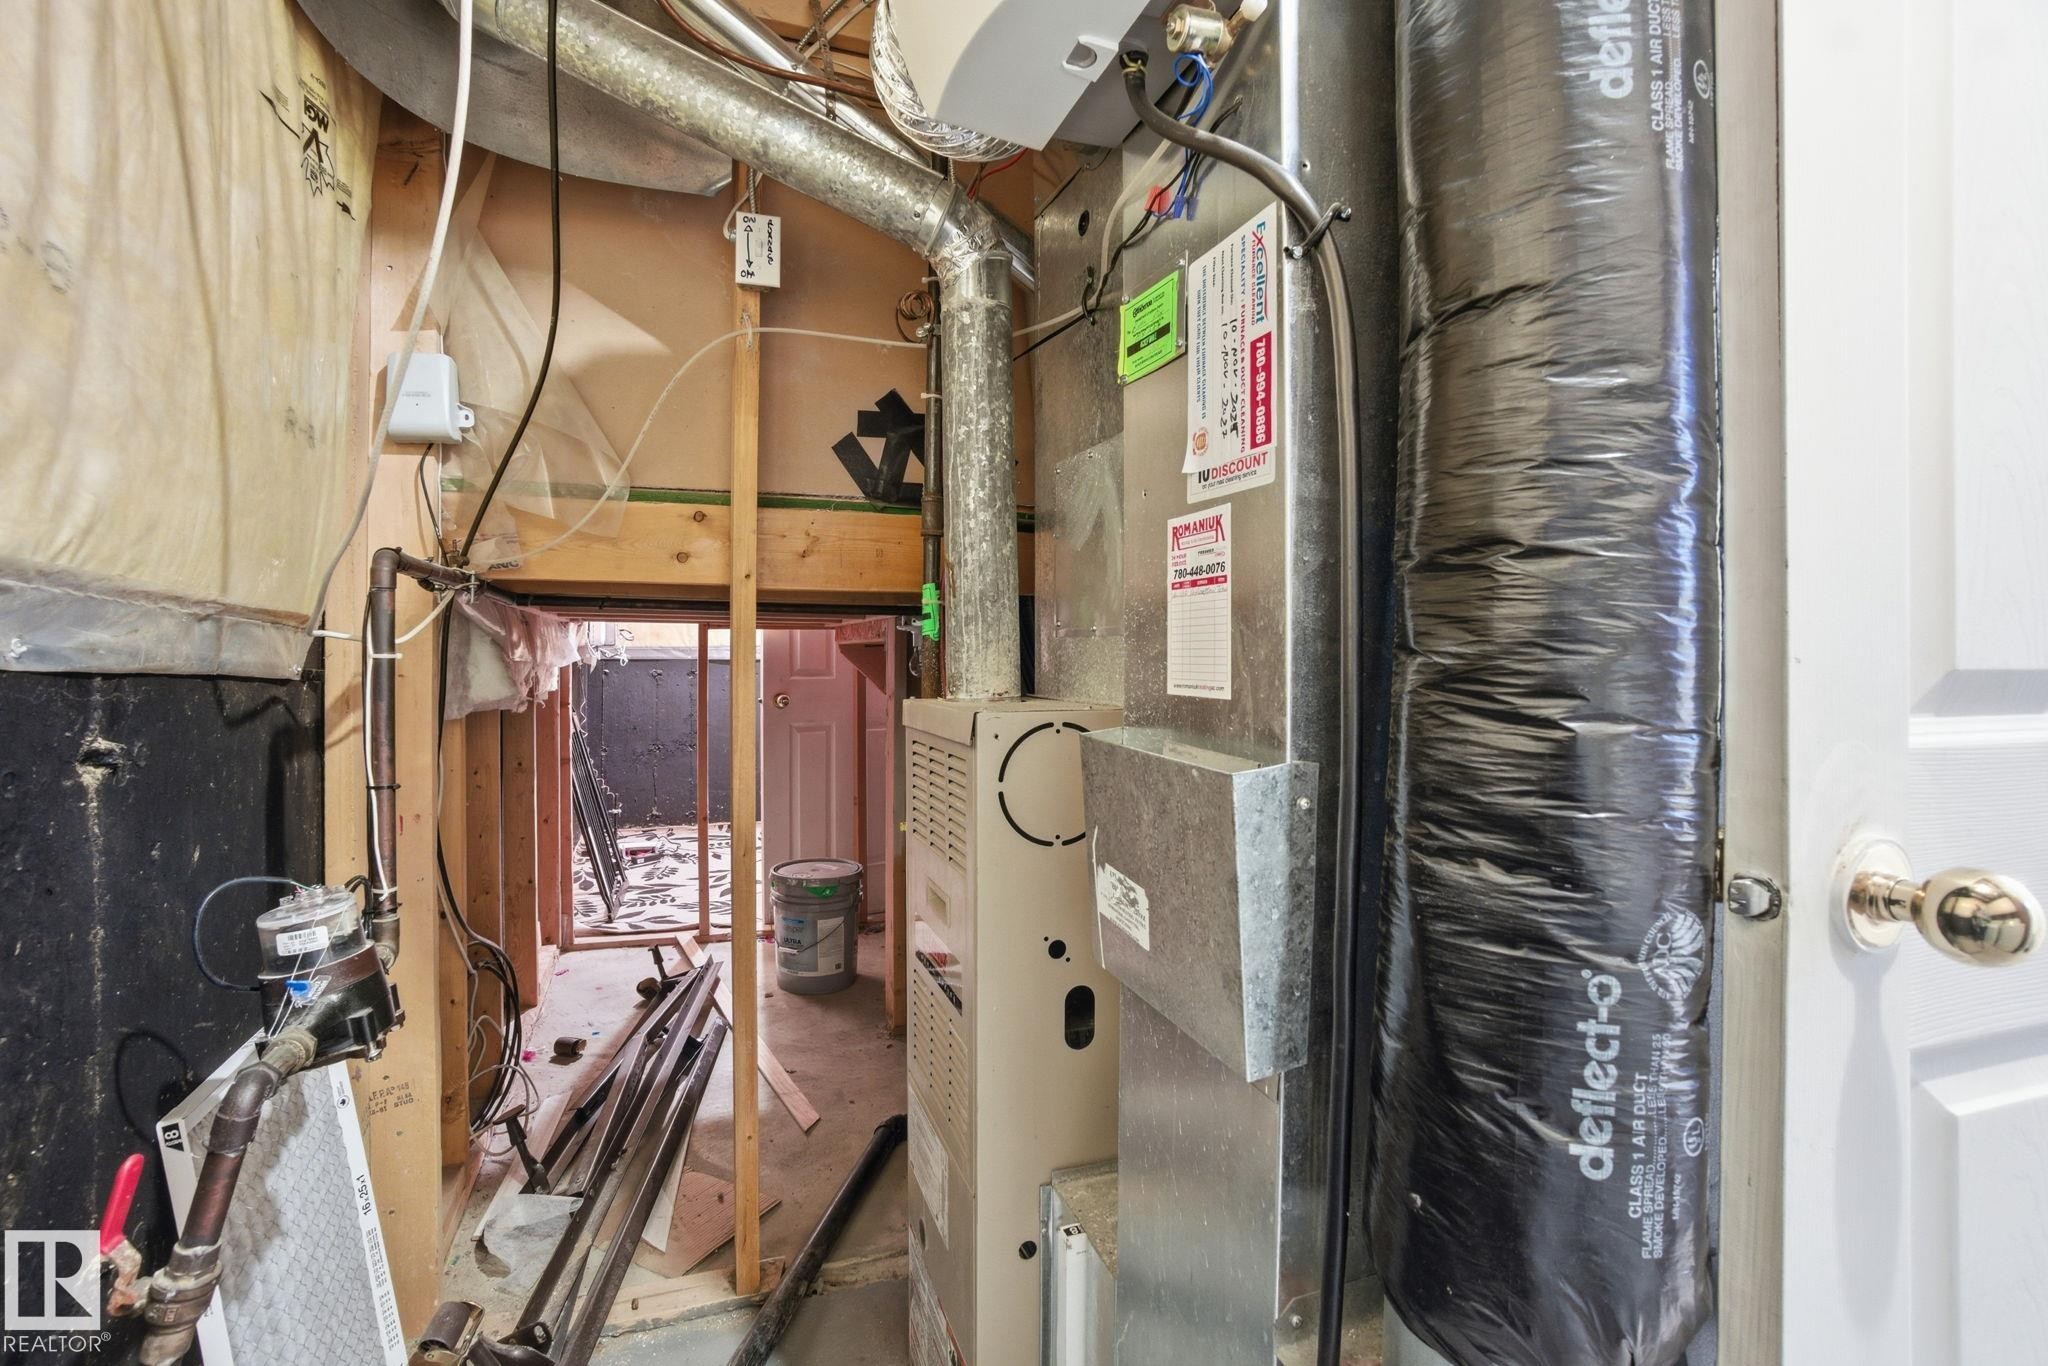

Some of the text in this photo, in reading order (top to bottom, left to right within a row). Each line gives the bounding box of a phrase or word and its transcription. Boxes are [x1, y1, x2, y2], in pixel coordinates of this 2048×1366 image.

[1649, 39, 1662, 65] AIR
[1652, 80, 1664, 132] CLASS
[1665, 131, 1675, 170] FLAME
[742, 216, 757, 224] ON
[1251, 220, 1268, 325] Excellent
[1211, 452, 1269, 480] DISCOUNT
[1171, 514, 1226, 552] ROMANIUK
[1173, 561, 1226, 580] 780-448-0076
[1652, 1033, 1662, 1049] 25
[1649, 1051, 1661, 1083] THAN
[163, 1129, 180, 1140] 8
[1628, 1071, 1648, 1219] CLASS 1 AIR DUCT
[1641, 1216, 1653, 1260] FLAME
[1652, 1213, 1664, 1259] SMOKE
